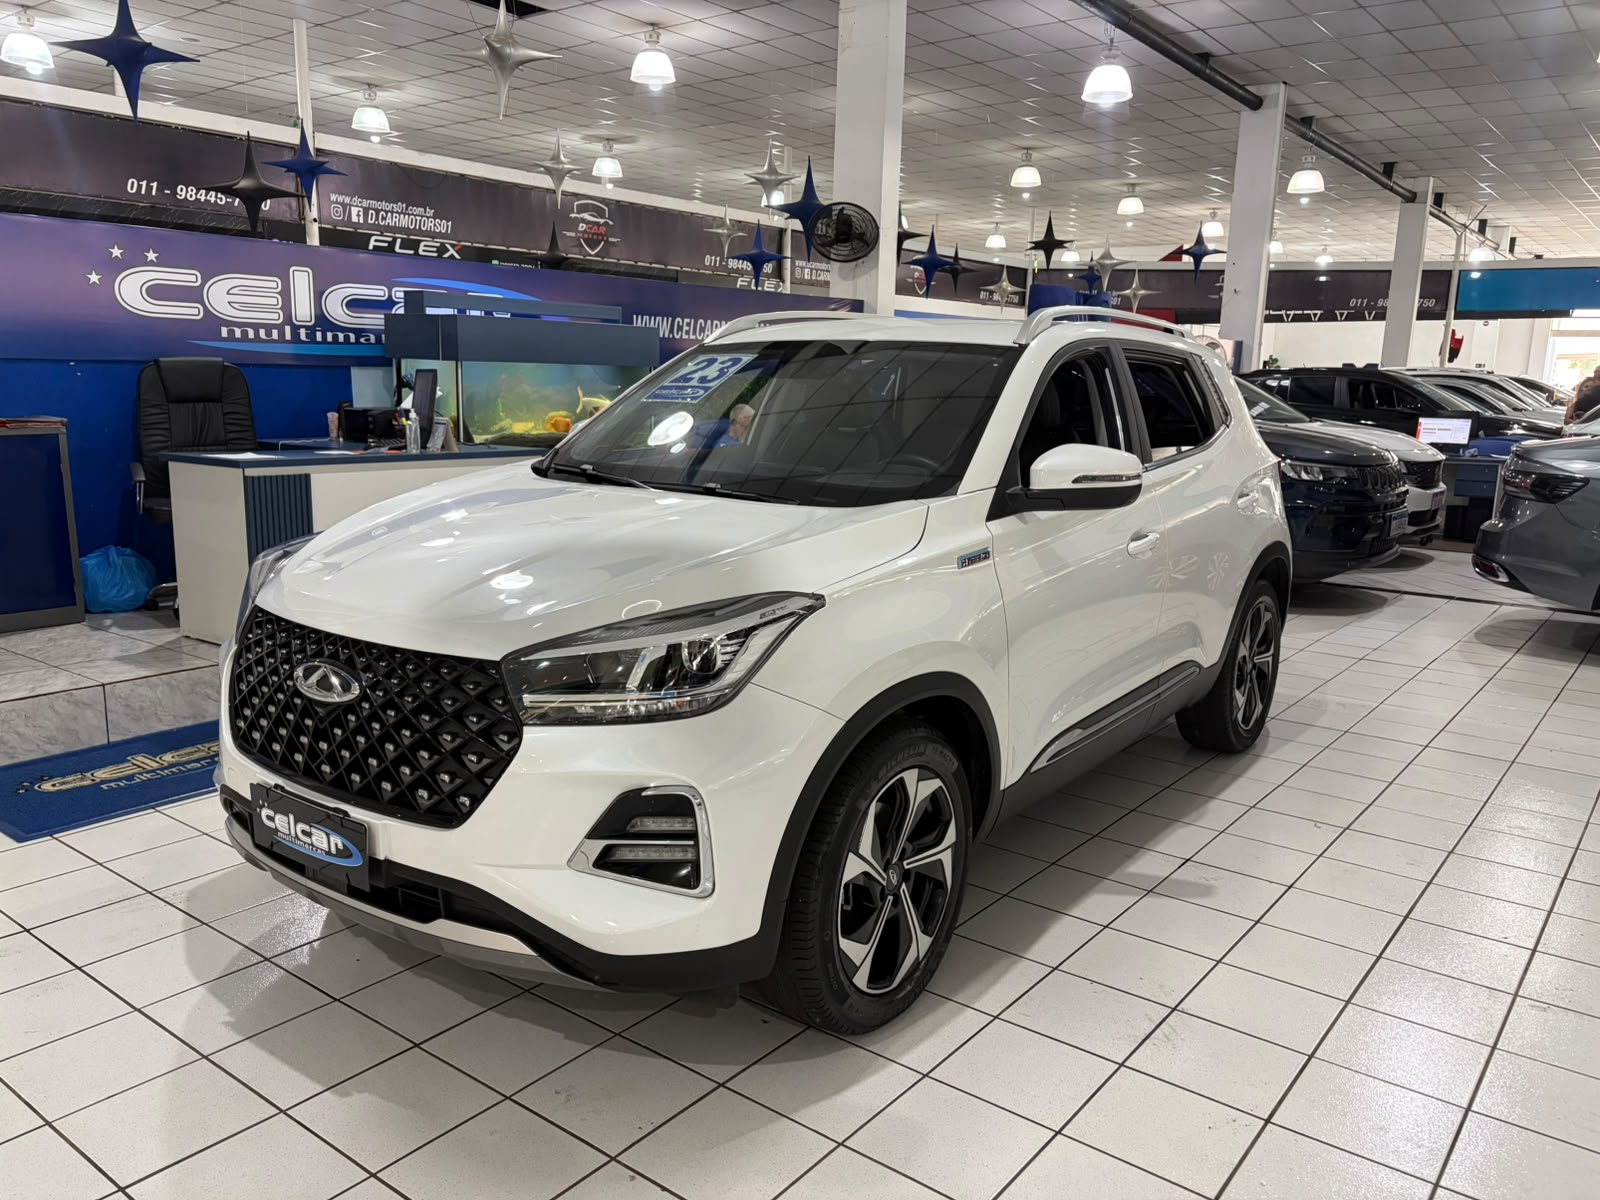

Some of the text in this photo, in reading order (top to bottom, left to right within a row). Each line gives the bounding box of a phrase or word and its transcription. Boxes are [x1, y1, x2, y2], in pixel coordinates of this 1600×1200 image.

[127, 178, 158, 196] 011
[176, 184, 271, 211] 98445-70
[330, 192, 435, 217] www.dcarmotors01.com.br
[368, 209, 453, 234] D.CARMOTORS01
[578, 222, 607, 235] DCAR
[368, 235, 463, 260] FLEX
[704, 255, 721, 267] 011
[114, 266, 510, 329] celc
[1349, 298, 1368, 307] 011
[221, 324, 385, 344] multima
[667, 357, 743, 384] 23
[34, 742, 220, 792] celc
[100, 756, 220, 790] multimar
[261, 807, 344, 854] celcar
